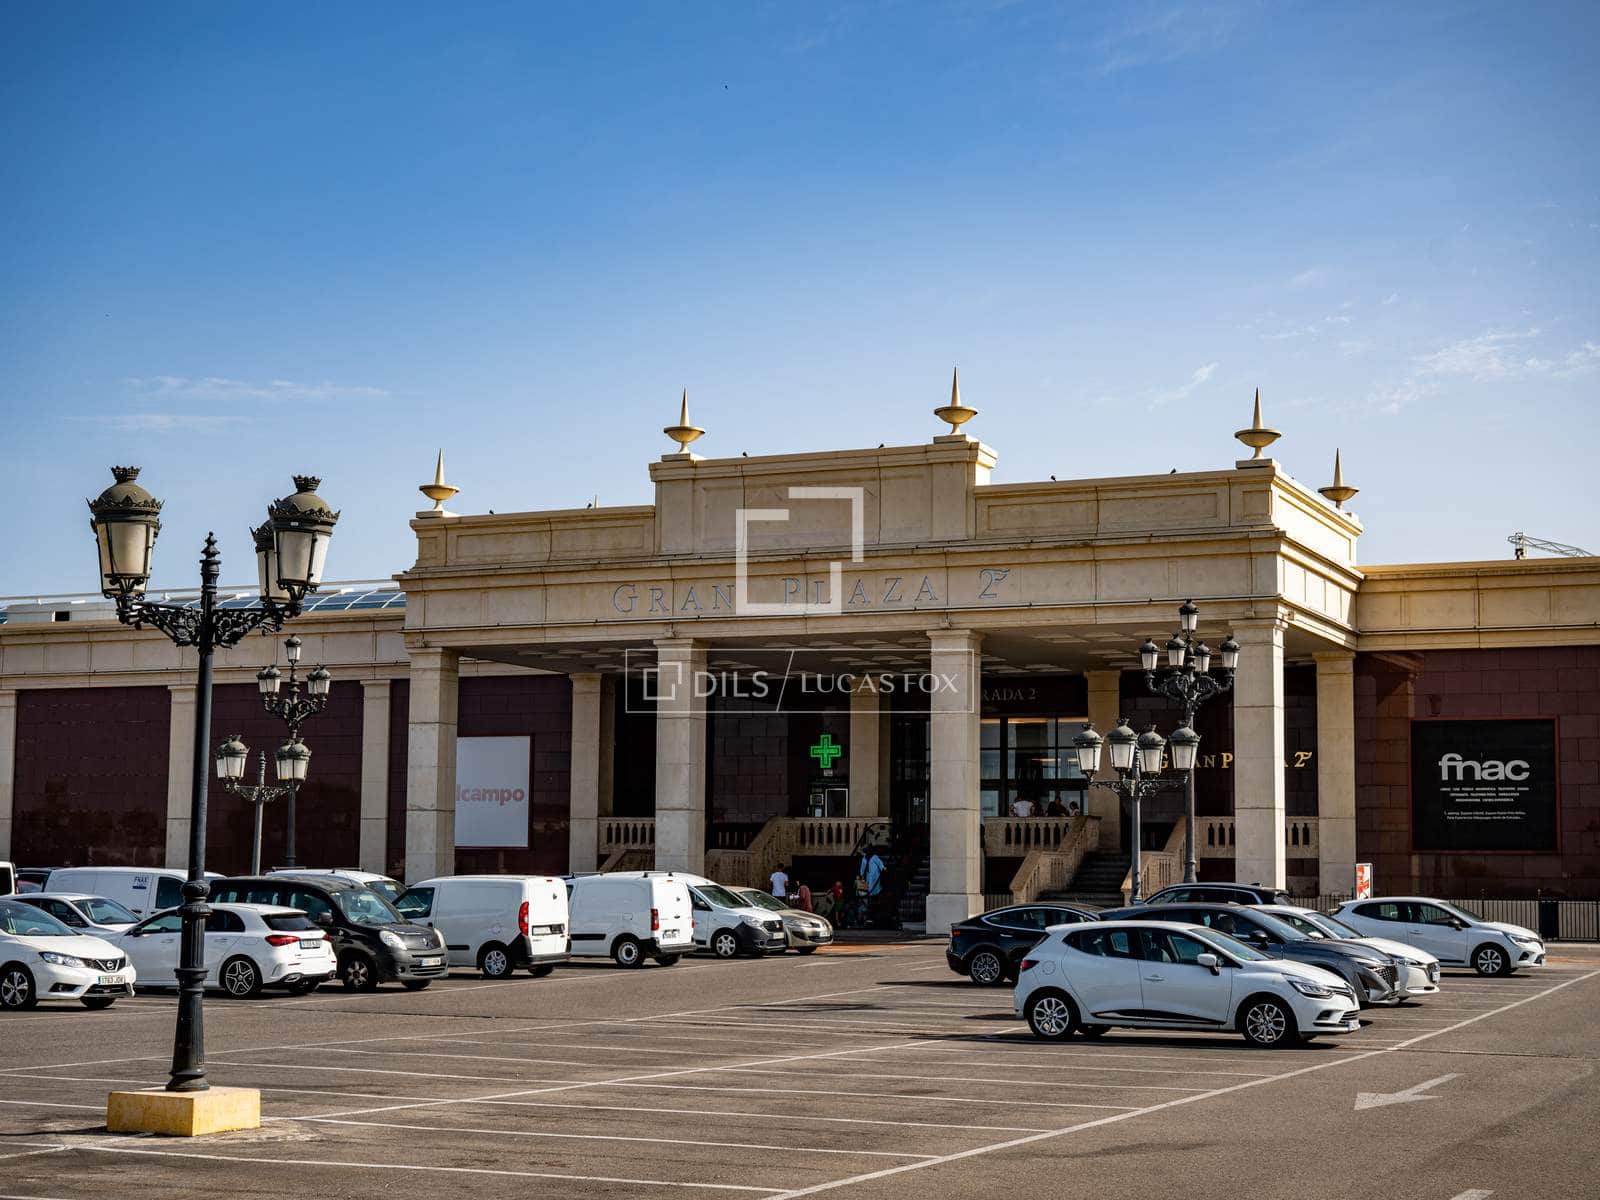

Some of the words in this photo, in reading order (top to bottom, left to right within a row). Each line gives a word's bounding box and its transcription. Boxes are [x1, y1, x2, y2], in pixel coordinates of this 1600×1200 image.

[613, 583, 736, 613] GRAN
[782, 575, 939, 605] PLAZA
[1439, 752, 1530, 780] fnac
[456, 783, 525, 806] lcampo
